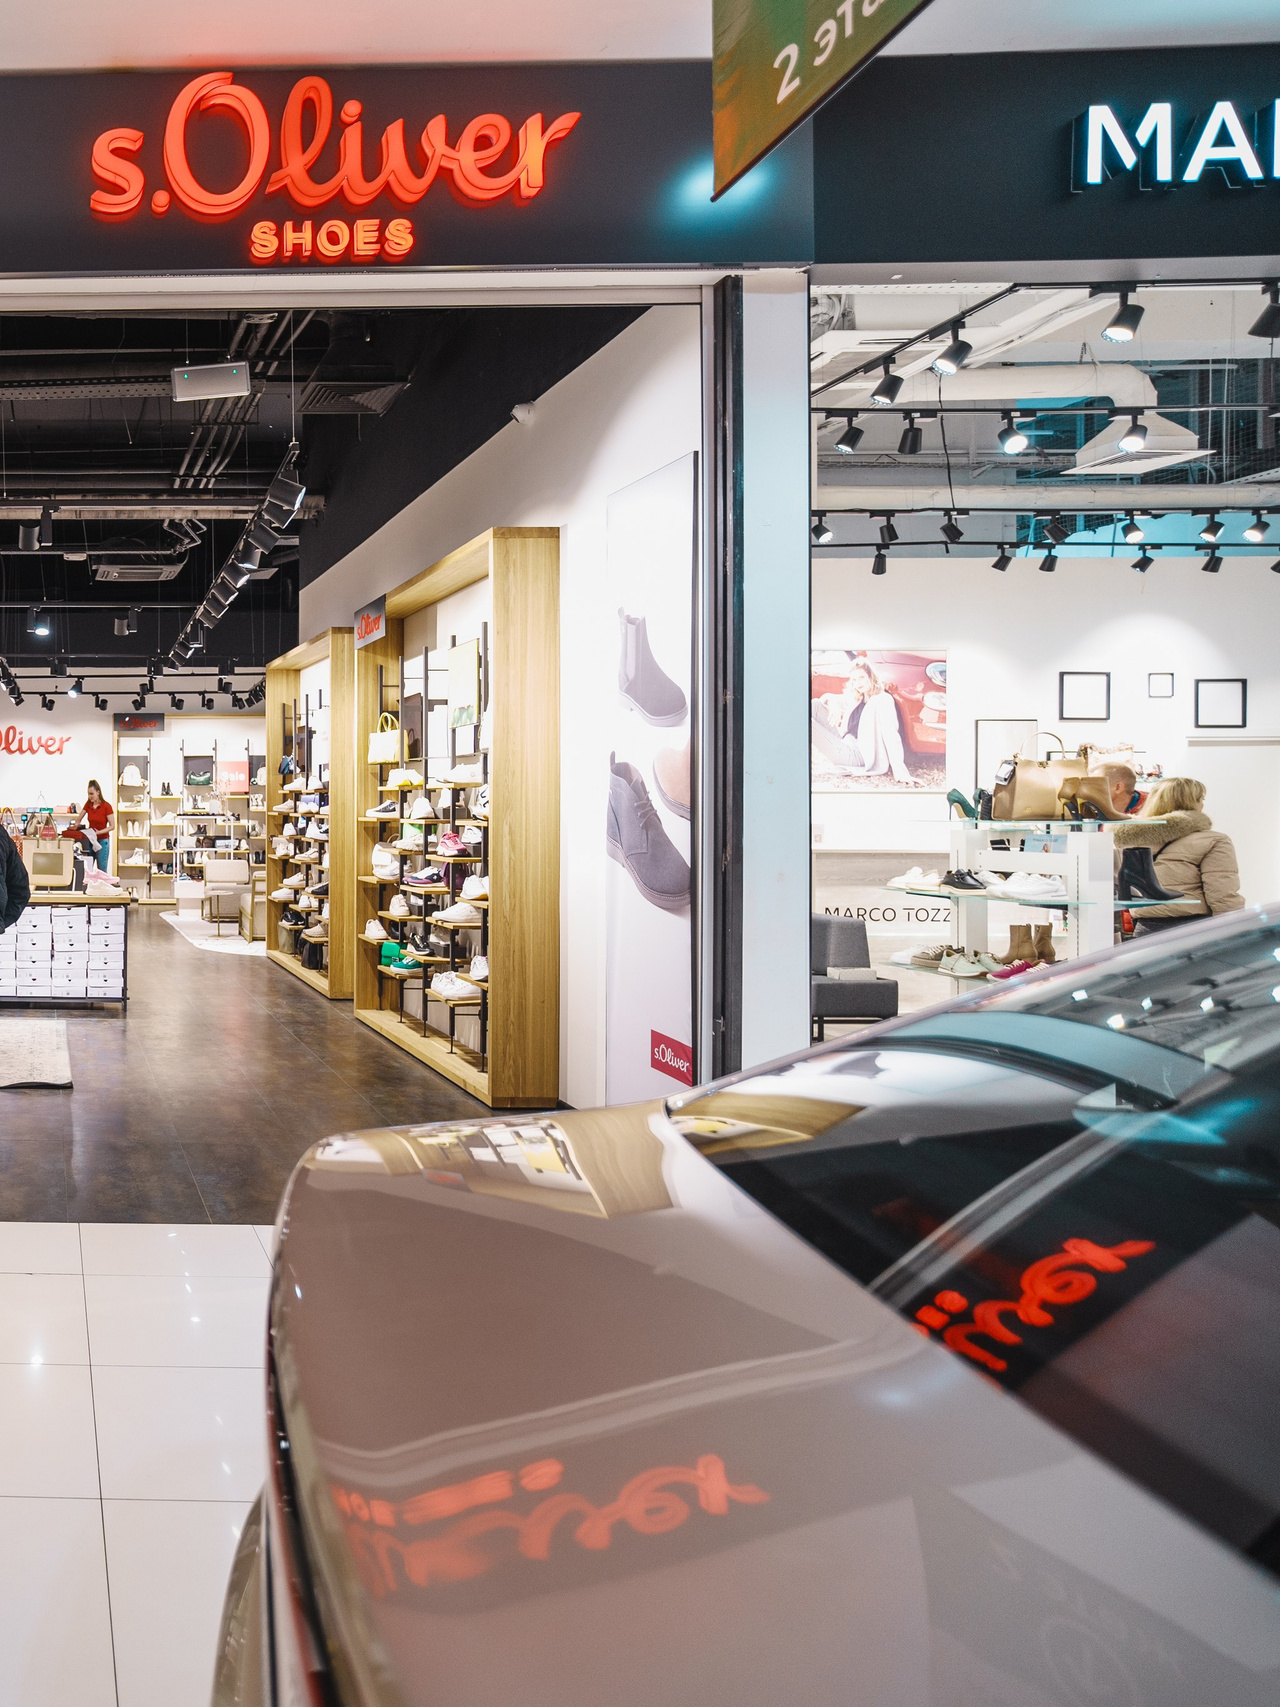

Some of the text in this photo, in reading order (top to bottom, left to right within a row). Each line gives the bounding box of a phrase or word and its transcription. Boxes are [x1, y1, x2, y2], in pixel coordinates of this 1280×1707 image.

[772, 43, 801, 105] 2
[89, 70, 583, 217] s.Oliver
[1084, 98, 1280, 186] MA
[250, 218, 415, 260] SHOES
[824, 906, 897, 923] MARCO
[653, 1043, 690, 1073] s.Oliver
